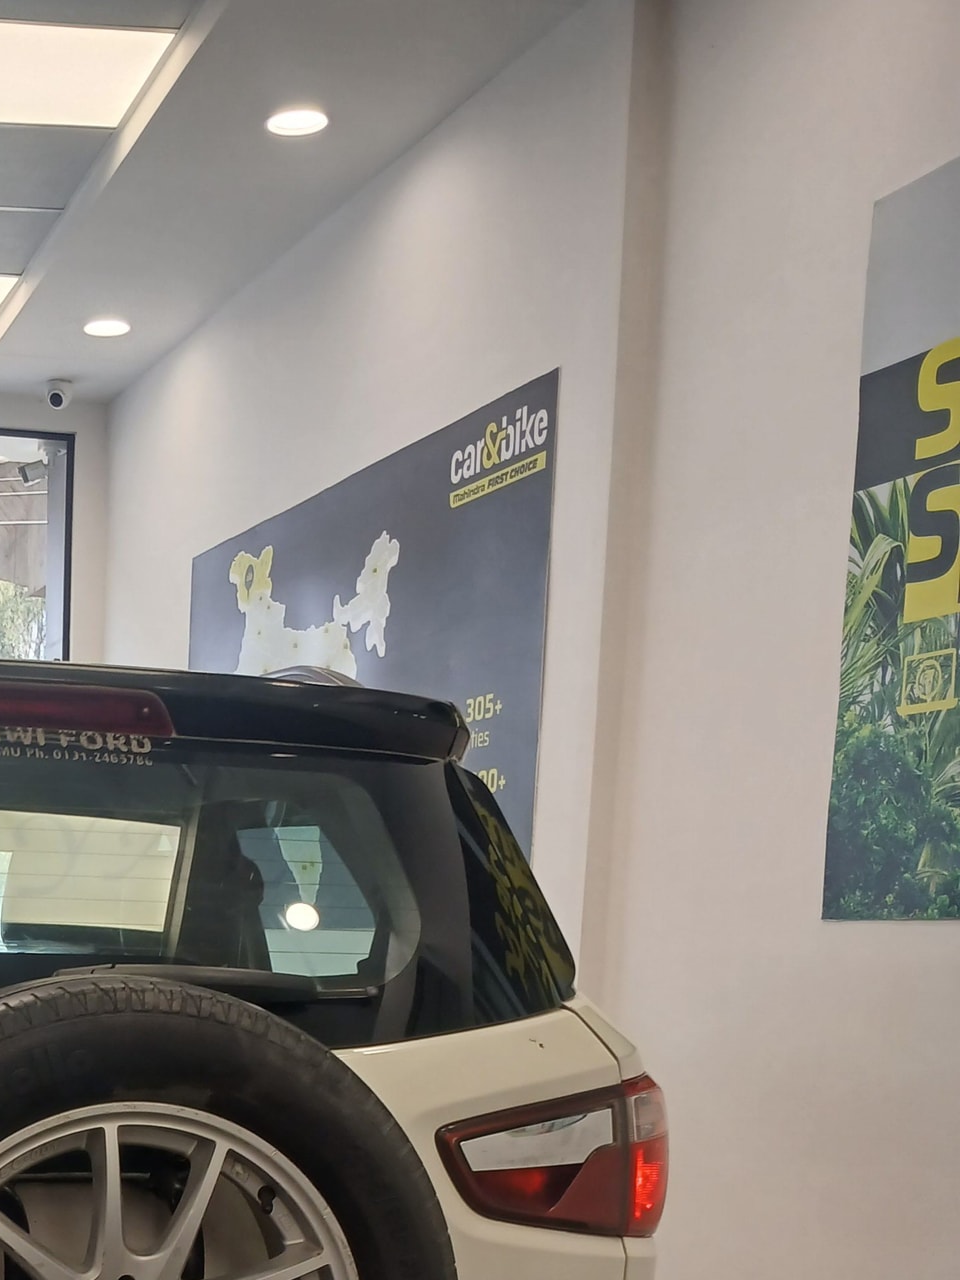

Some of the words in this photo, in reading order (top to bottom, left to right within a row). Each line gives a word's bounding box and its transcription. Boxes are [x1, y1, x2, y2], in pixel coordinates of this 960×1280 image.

[450, 405, 548, 484] car&bike
[486, 470, 511, 490] FIRST
[510, 458, 539, 479] CHOICE
[465, 693, 502, 723] 305+
[469, 727, 490, 749] ties
